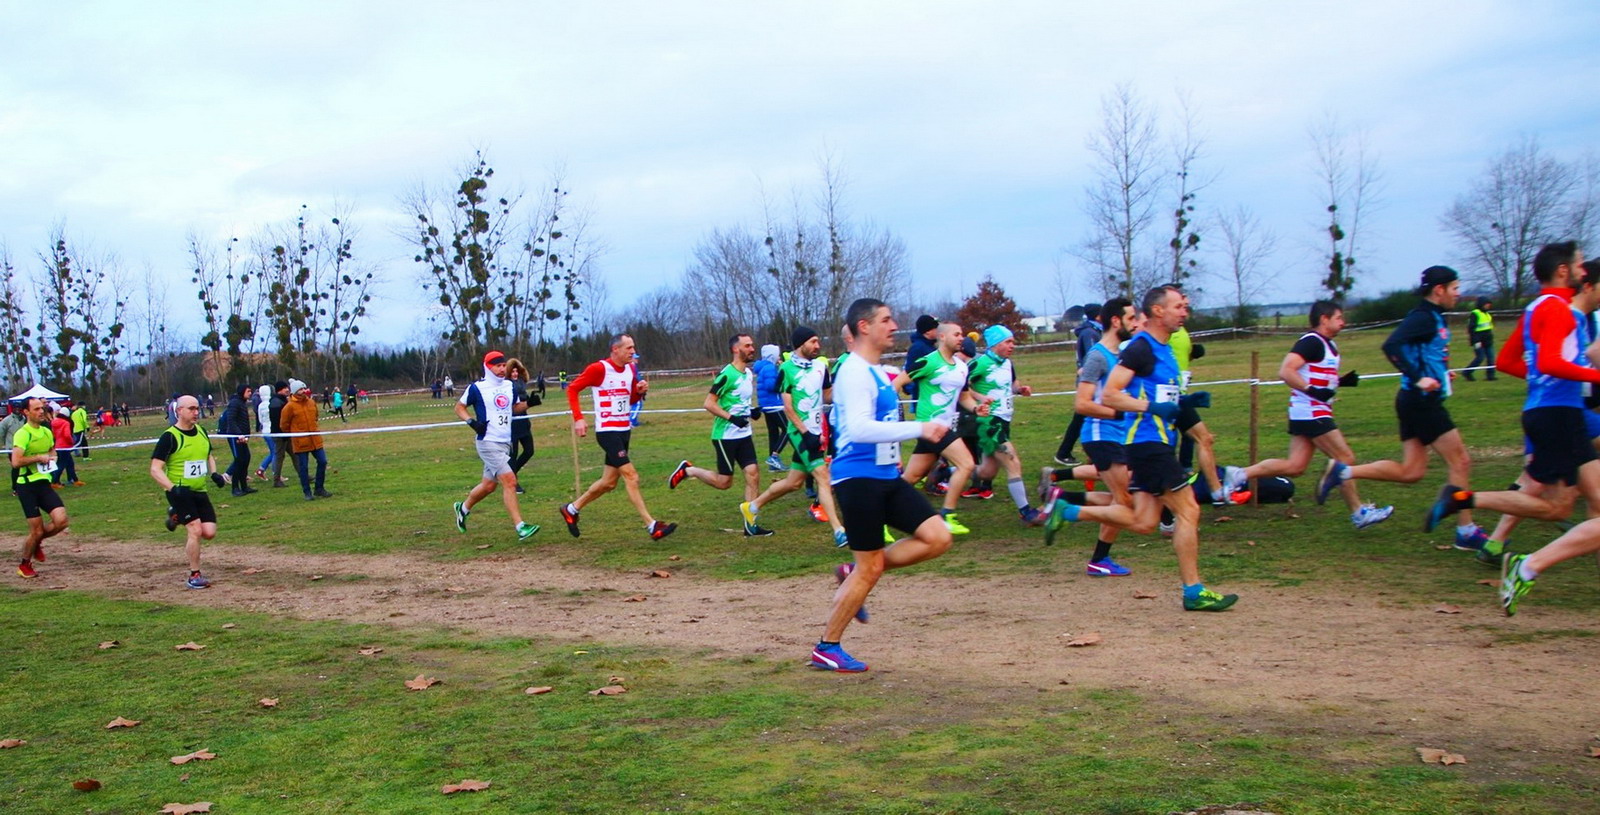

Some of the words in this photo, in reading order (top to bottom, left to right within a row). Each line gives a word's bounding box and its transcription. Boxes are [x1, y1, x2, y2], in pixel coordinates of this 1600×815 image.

[618, 401, 626, 412] 37
[498, 415, 508, 426] 34
[190, 465, 201, 476] 21
